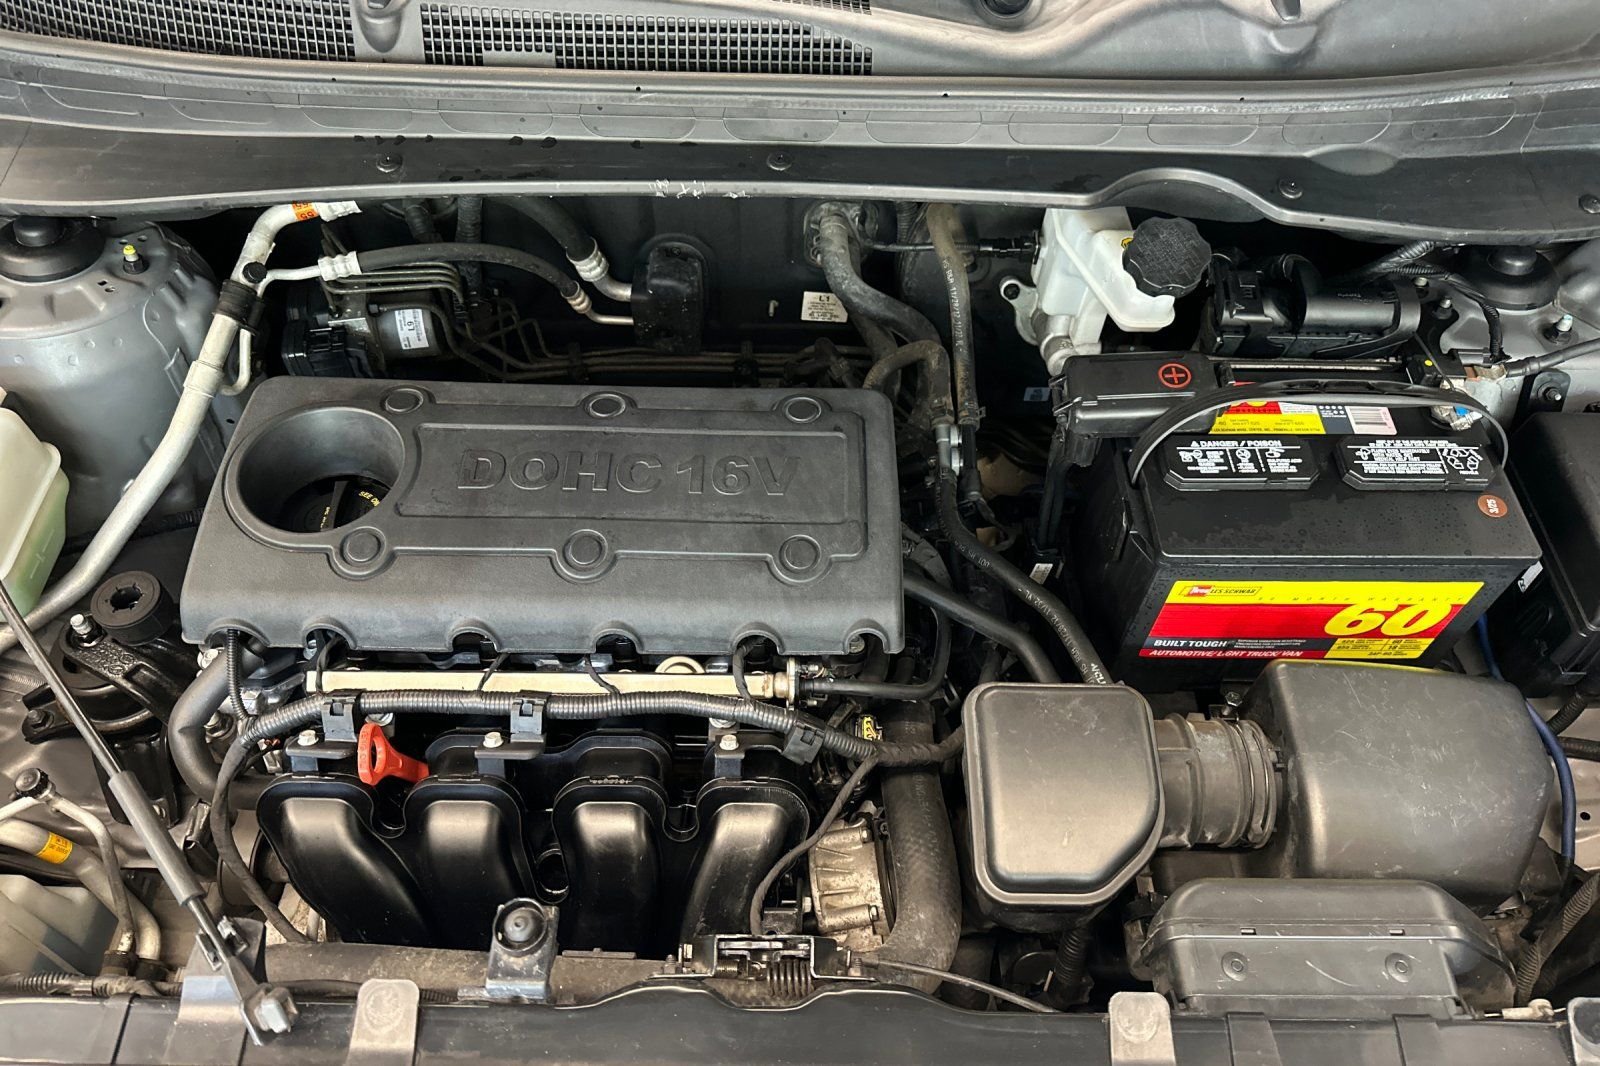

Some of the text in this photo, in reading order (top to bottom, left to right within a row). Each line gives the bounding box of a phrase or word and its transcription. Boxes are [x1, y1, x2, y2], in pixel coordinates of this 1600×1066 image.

[1200, 440, 1238, 448] DANGER
[457, 450, 801, 496] DOHC 16V
[358, 490, 373, 499] SEE
[1324, 602, 1452, 637] 60
[1154, 639, 1228, 648] BUILT TOUGH
